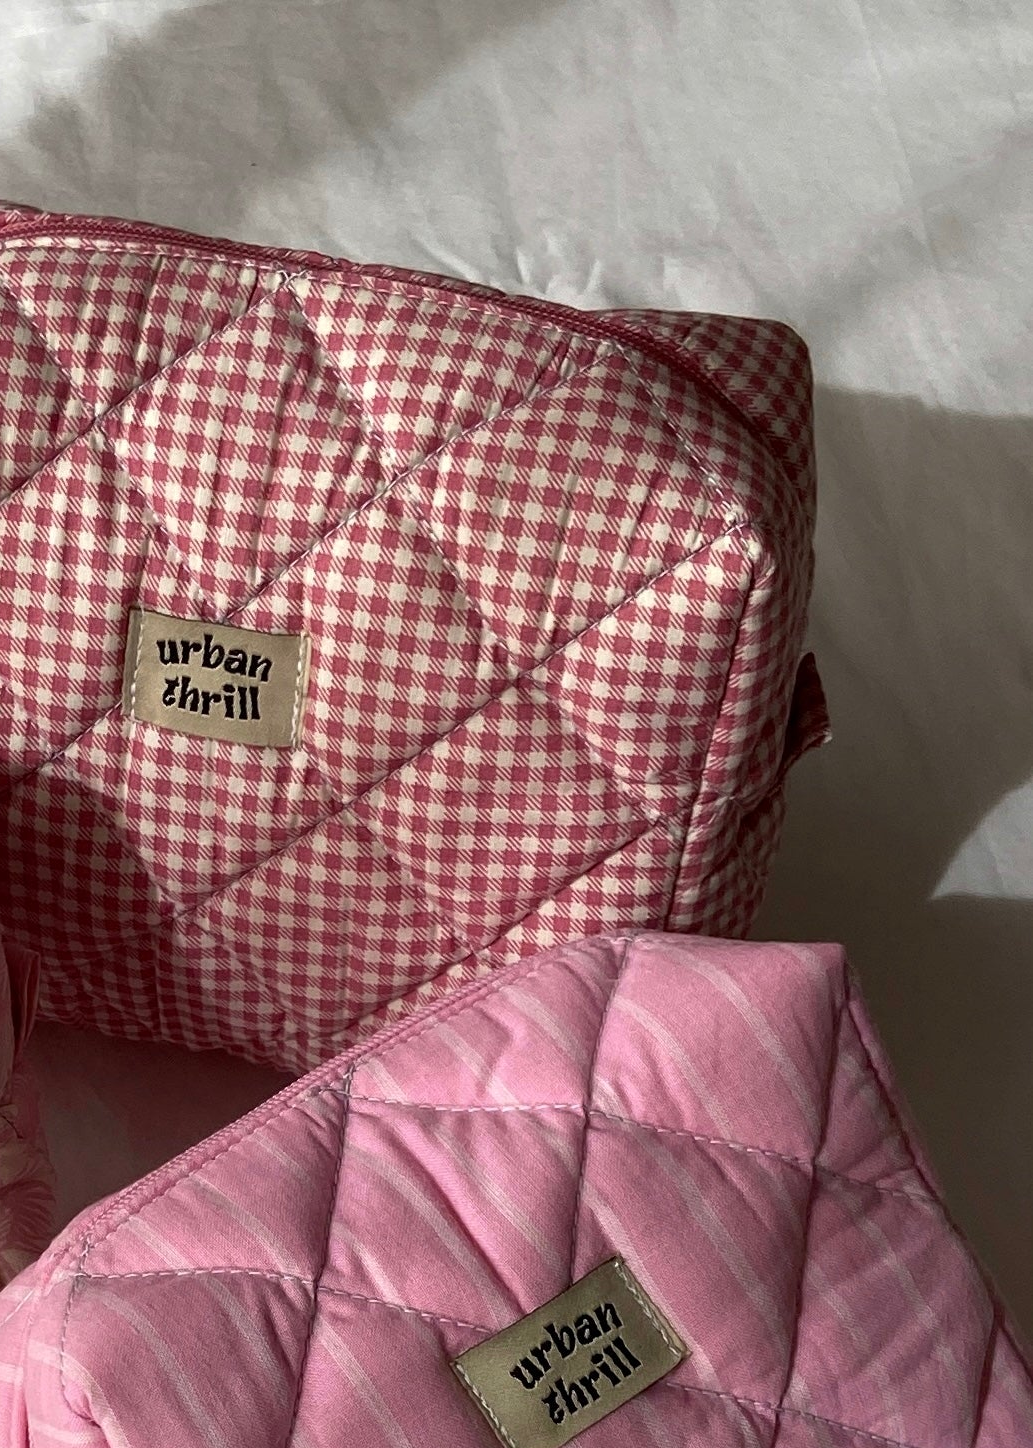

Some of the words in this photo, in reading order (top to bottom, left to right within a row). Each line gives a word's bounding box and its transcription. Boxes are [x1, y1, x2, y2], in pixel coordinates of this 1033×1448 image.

[155, 633, 273, 682] urban
[161, 675, 261, 720] thrill
[509, 1303, 624, 1390] urban
[541, 1335, 642, 1425] thrill
